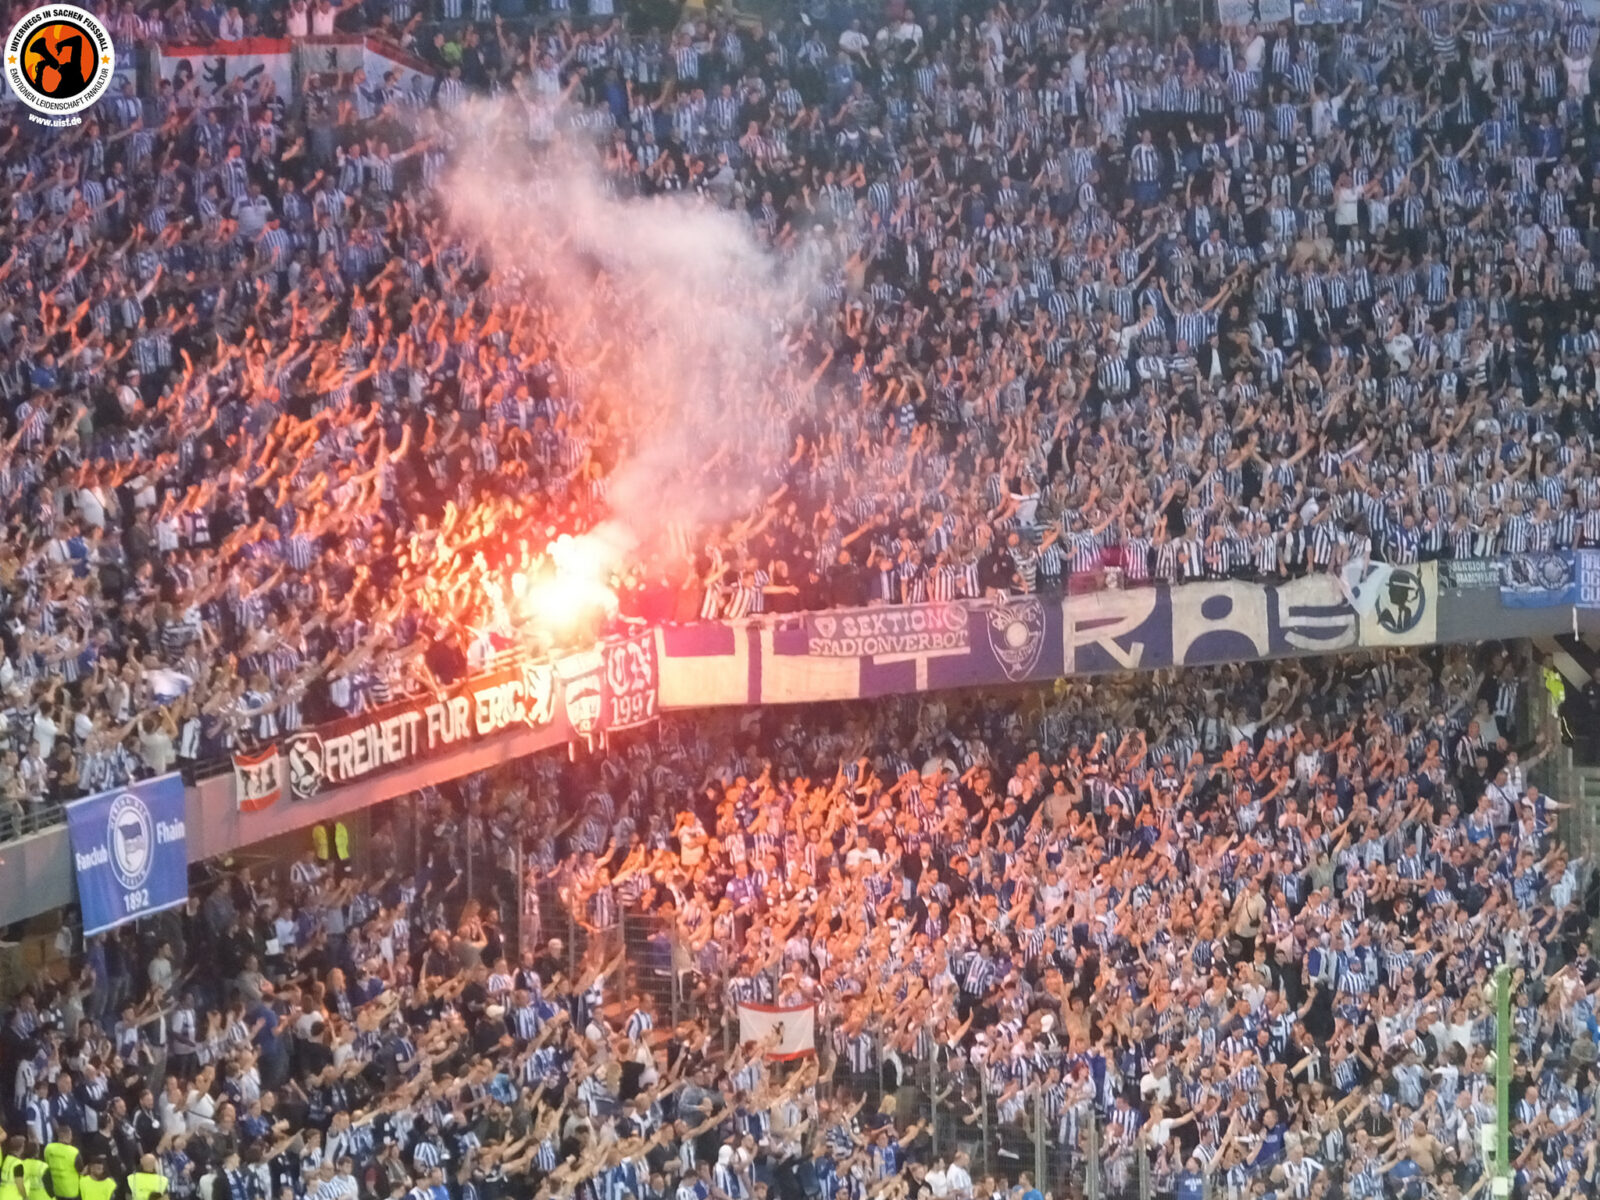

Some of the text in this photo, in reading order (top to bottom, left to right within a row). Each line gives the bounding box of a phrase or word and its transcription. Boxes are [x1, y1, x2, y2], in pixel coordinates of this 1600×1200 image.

[842, 608, 944, 636] SEKTION
[808, 629, 968, 656] STADIONVERBOT
[611, 690, 656, 725] 1997
[323, 711, 422, 783] FREIHEIT
[474, 681, 526, 735] ERIC
[156, 818, 186, 844] Fhain
[75, 844, 108, 871] Fanclub
[124, 889, 149, 912] 1892
